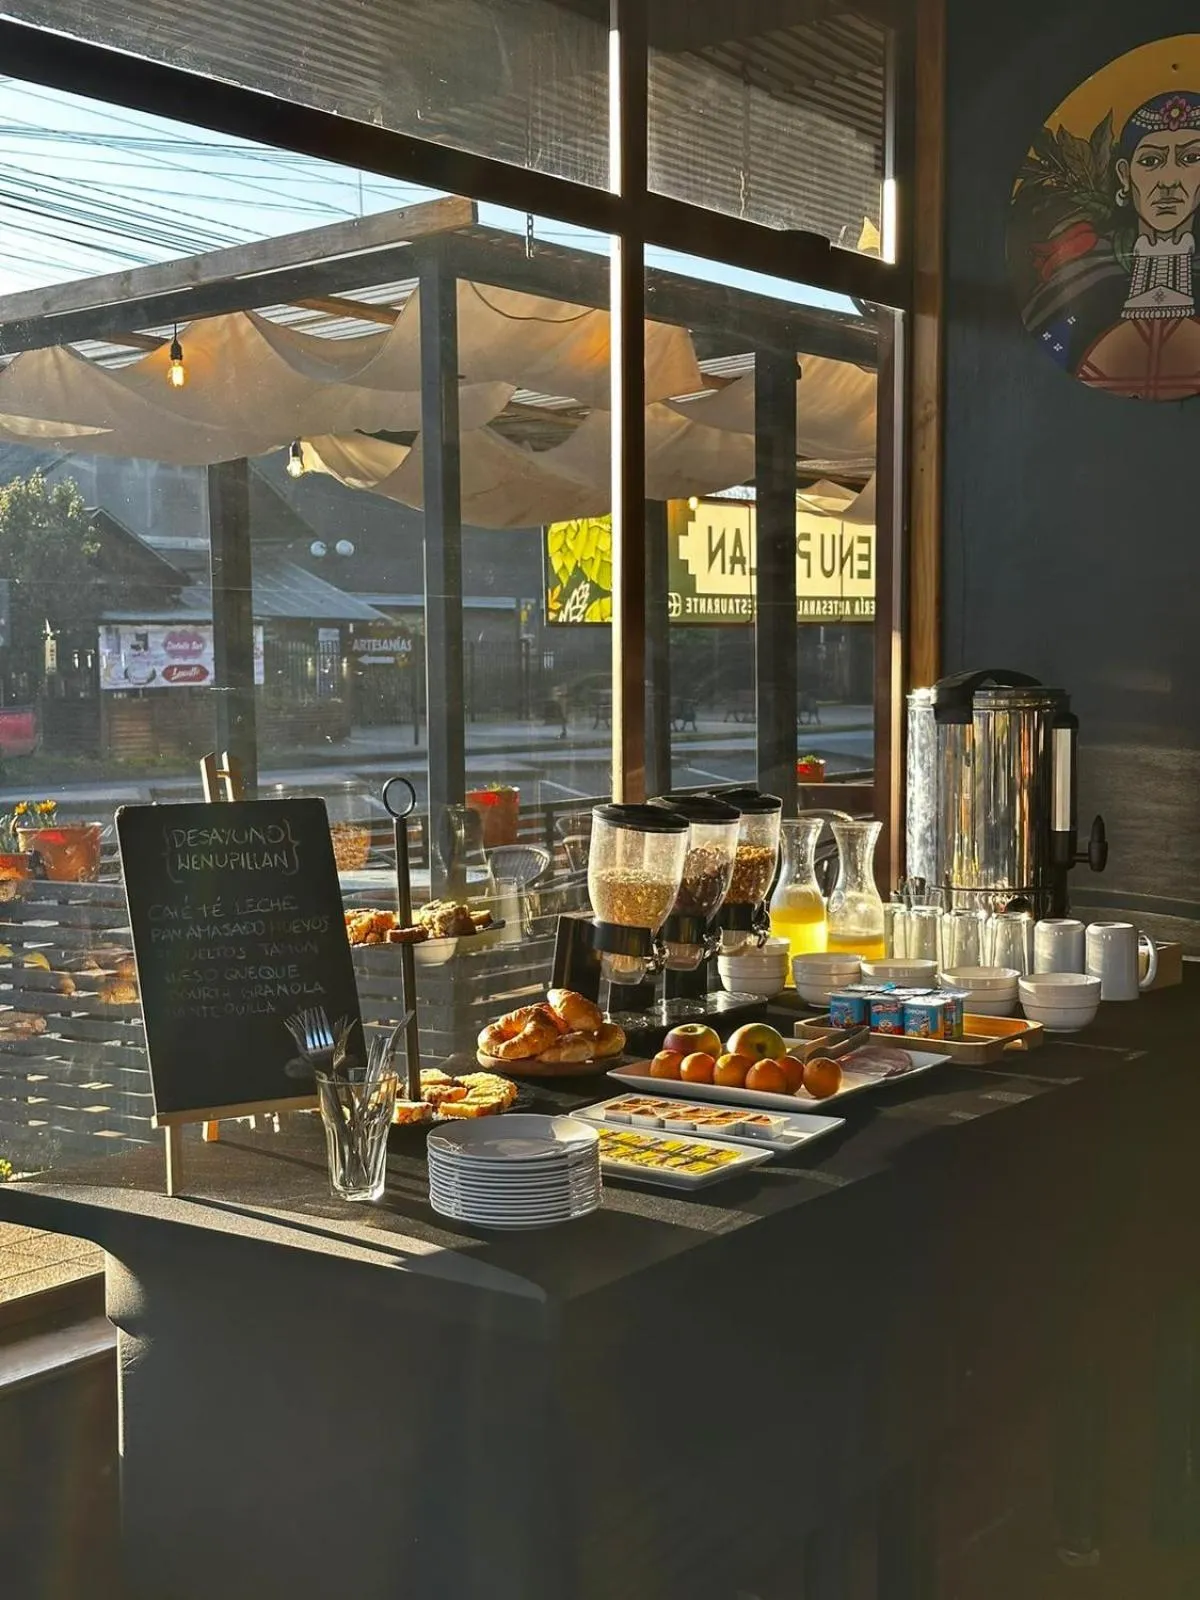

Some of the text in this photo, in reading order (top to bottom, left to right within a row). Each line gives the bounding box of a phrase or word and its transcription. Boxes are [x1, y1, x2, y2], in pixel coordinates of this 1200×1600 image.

[177, 850, 289, 871] WENUPILLAN
[233, 894, 299, 915] LECHE
[150, 927, 182, 944] PAN
[186, 919, 265, 940] AMASADO
[160, 964, 300, 984] UESO QUEQUE
[241, 981, 327, 1001] GRANOLA
